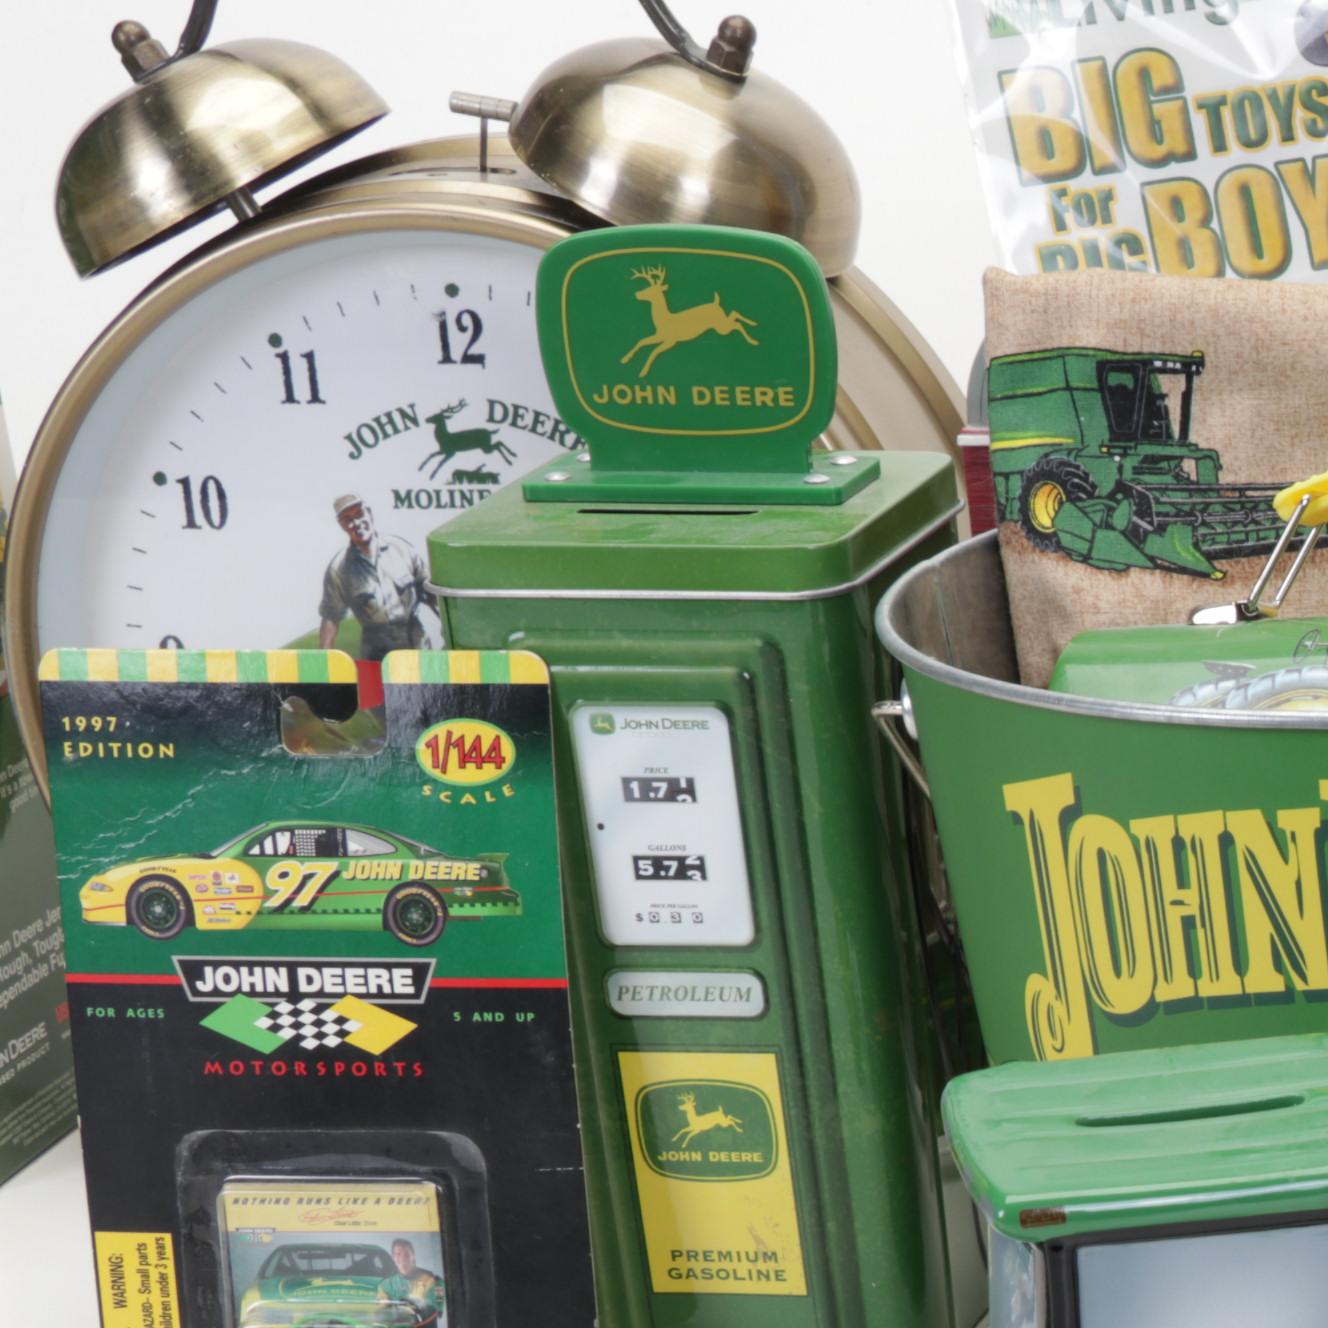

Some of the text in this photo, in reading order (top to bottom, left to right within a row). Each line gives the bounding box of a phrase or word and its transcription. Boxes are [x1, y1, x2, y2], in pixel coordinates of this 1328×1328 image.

[998, 46, 1198, 186] BIG
[1048, 183, 1117, 232] For
[436, 309, 487, 369] 12
[273, 349, 327, 405] 11
[593, 384, 796, 408] JOHN DEERE
[343, 403, 421, 460] JOHN
[174, 474, 229, 531] 10
[63, 716, 118, 733] 1997
[620, 717, 710, 731] JOHN DEERE
[64, 741, 175, 759] EDITION
[424, 730, 506, 773] 1/144
[643, 767, 669, 775] PRICE
[422, 784, 516, 805] SCALE
[647, 844, 687, 852] GALLONS
[264, 860, 481, 912] 97 JOHN DEERE
[12, 918, 44, 949] Deere
[49, 951, 66, 972] Fu
[195, 966, 416, 995] JOHN DEERE
[616, 985, 752, 1003] PETROLEUM
[86, 1007, 166, 1019] FOR AGES
[453, 1011, 536, 1023] 5 AND UP
[8, 1022, 48, 1060] DEERE
[203, 1059, 425, 1078] MOTORSPORTS
[658, 1151, 763, 1163] JOHN DEERE
[232, 1197, 291, 1206] NOTHING
[297, 1197, 331, 1206] RUNS
[338, 1197, 369, 1206] LIKE
[136, 1242, 152, 1267] parts
[155, 1236, 170, 1261] years
[670, 1249, 779, 1265] PREMIUM
[108, 1253, 128, 1309] WARNING:
[136, 1268, 152, 1295] Small
[155, 1271, 170, 1299] under
[667, 1267, 788, 1283] GASOLINE
